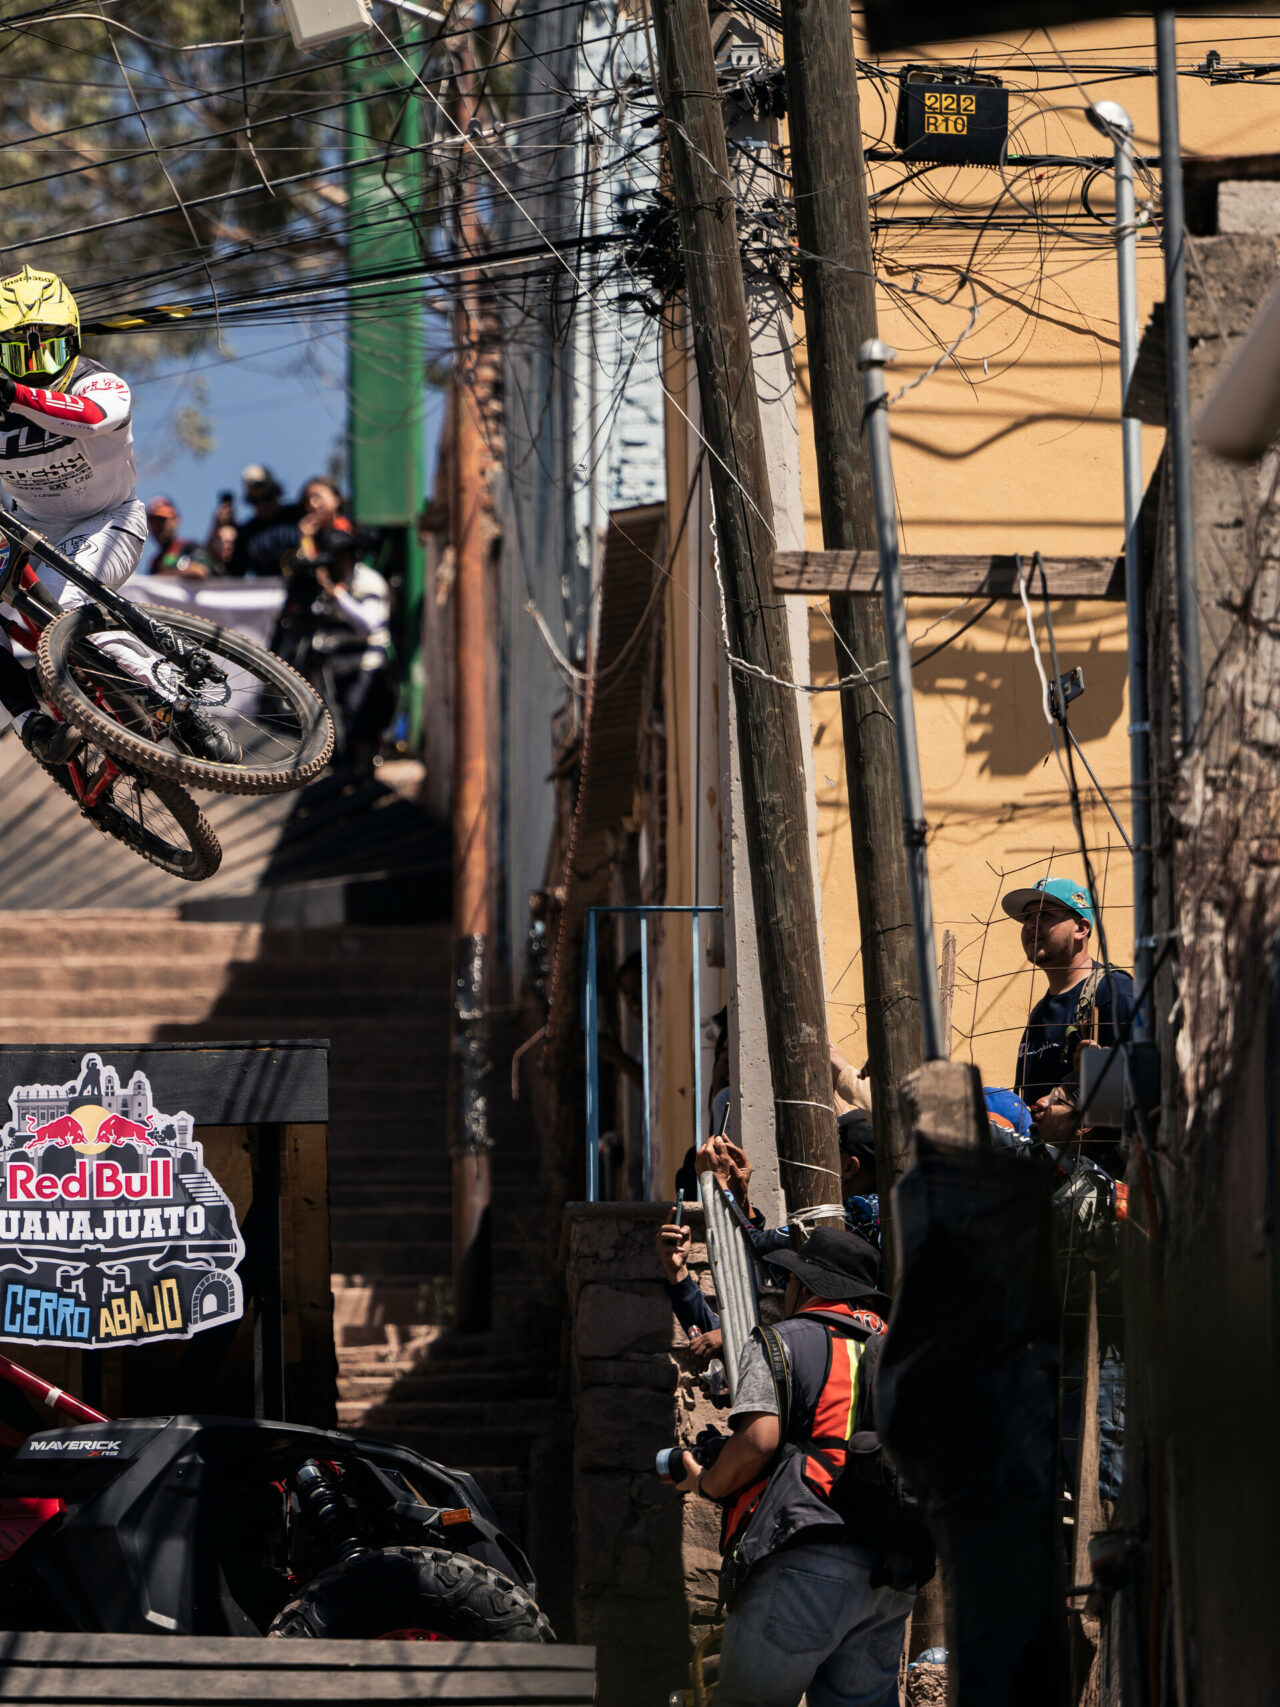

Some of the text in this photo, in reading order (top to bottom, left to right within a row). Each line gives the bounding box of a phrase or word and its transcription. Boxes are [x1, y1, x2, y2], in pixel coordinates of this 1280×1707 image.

[927, 94, 974, 112] 222
[926, 116, 966, 133] R10
[8, 1159, 172, 1200] Red Bull
[4, 1278, 184, 1338] CERRO ABAJO
[29, 1440, 123, 1451] MAVERICK
